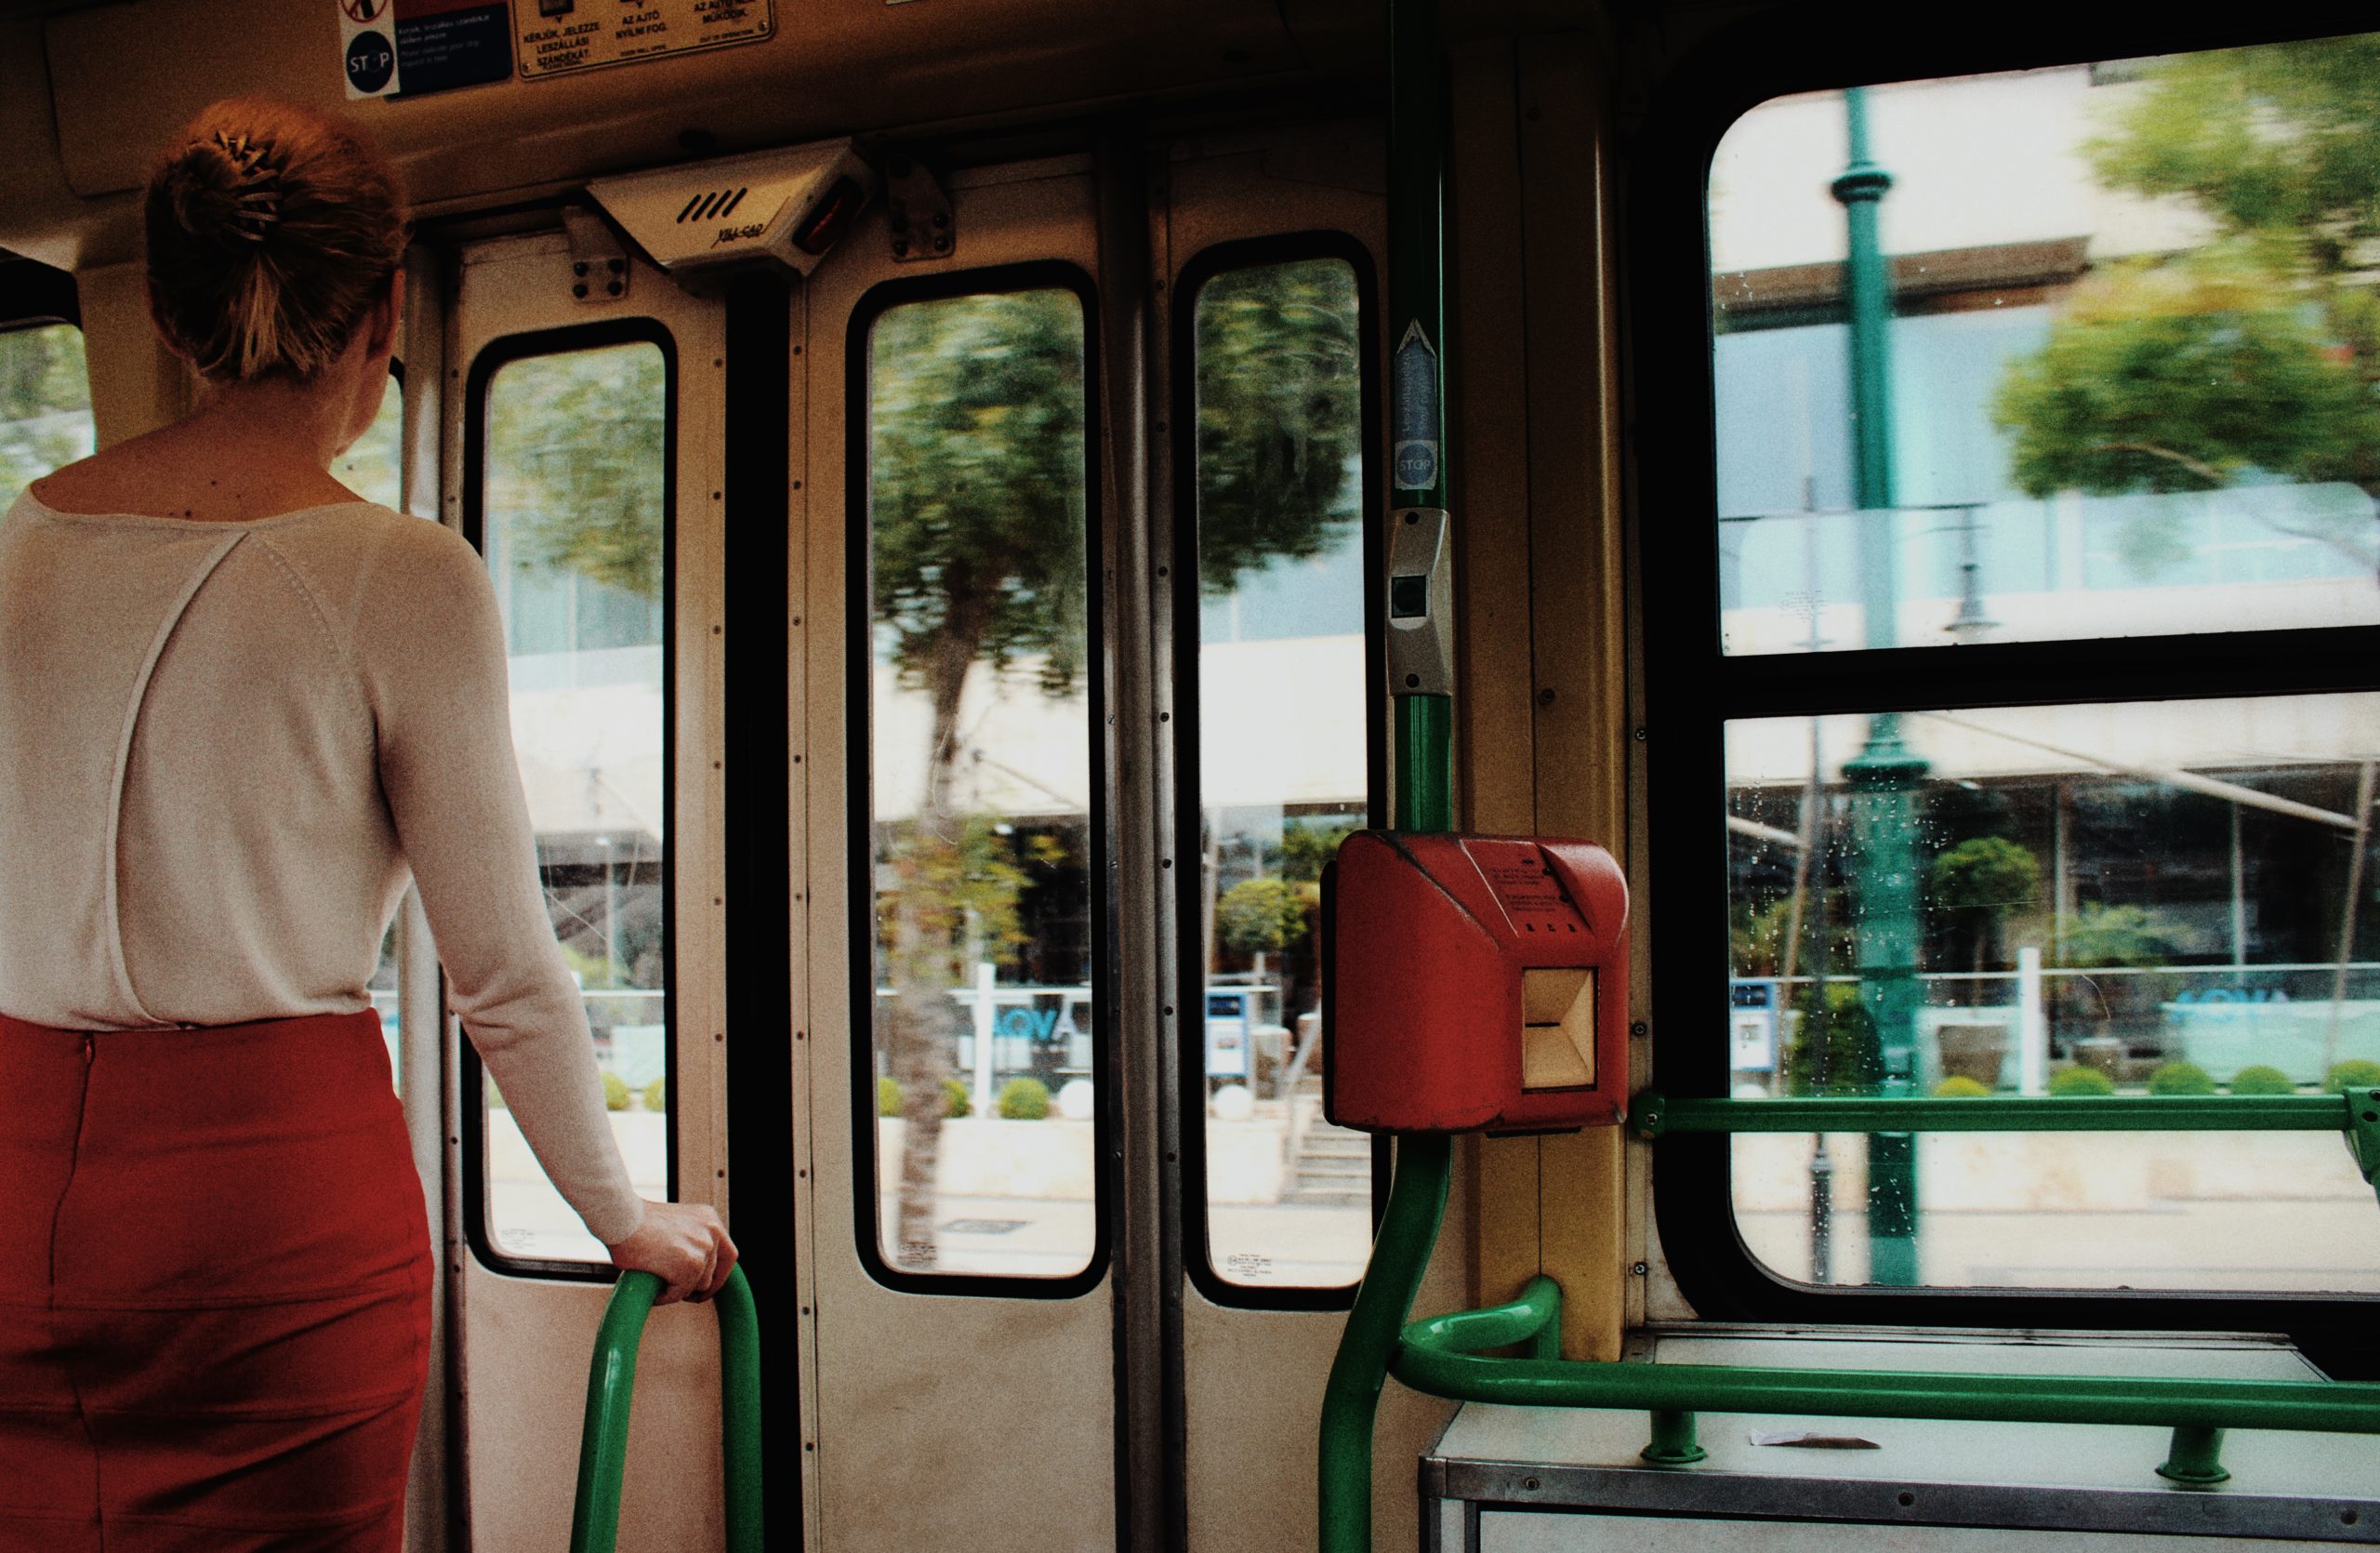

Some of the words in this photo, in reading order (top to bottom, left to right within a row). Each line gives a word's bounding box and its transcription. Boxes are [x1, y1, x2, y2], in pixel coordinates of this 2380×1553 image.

[622, 16, 634, 24] AZ
[562, 21, 600, 36] JELEZZE
[536, 36, 589, 54] LESZÁLLÁSI
[1399, 458, 1431, 471] STOP
